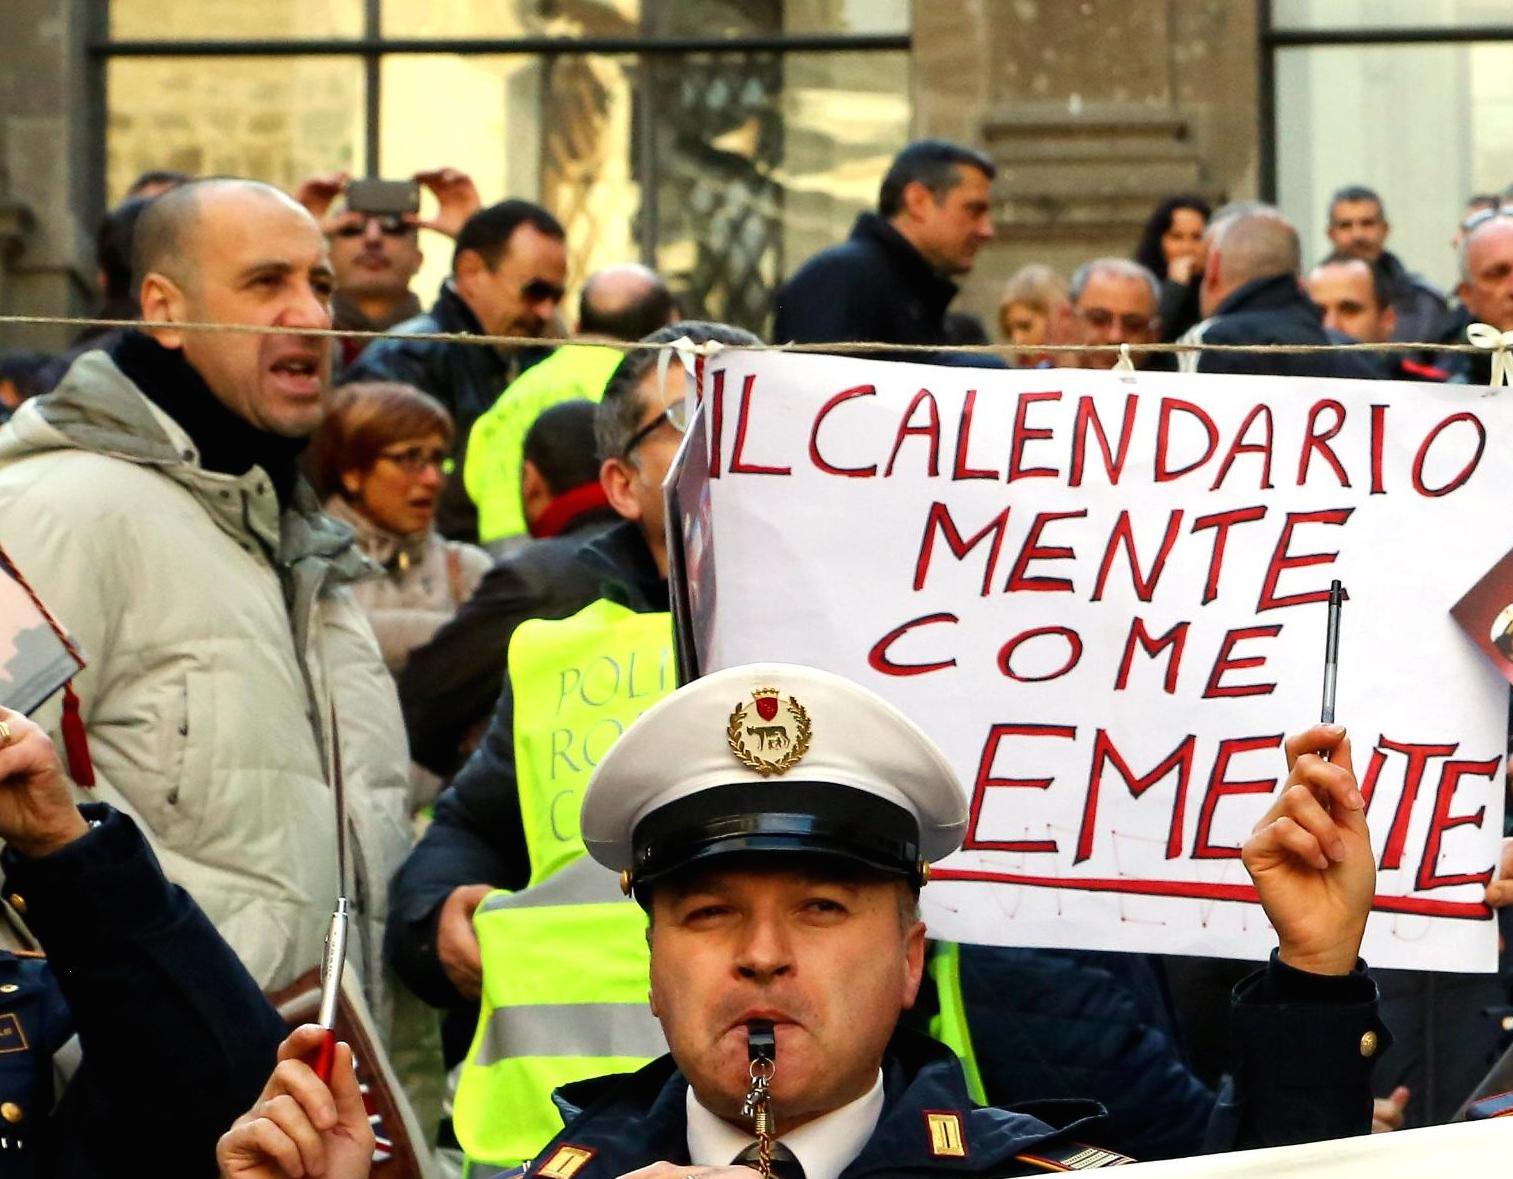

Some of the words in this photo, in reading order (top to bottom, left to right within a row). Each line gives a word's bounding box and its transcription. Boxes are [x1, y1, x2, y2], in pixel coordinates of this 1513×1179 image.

[707, 367, 793, 478] IL
[807, 381, 1488, 498] CALENDARIO
[911, 500, 1351, 615] MENTE
[556, 651, 669, 715] POLI
[866, 610, 1284, 699] COME
[550, 715, 626, 780] RO
[960, 722, 1502, 893] EMETE
